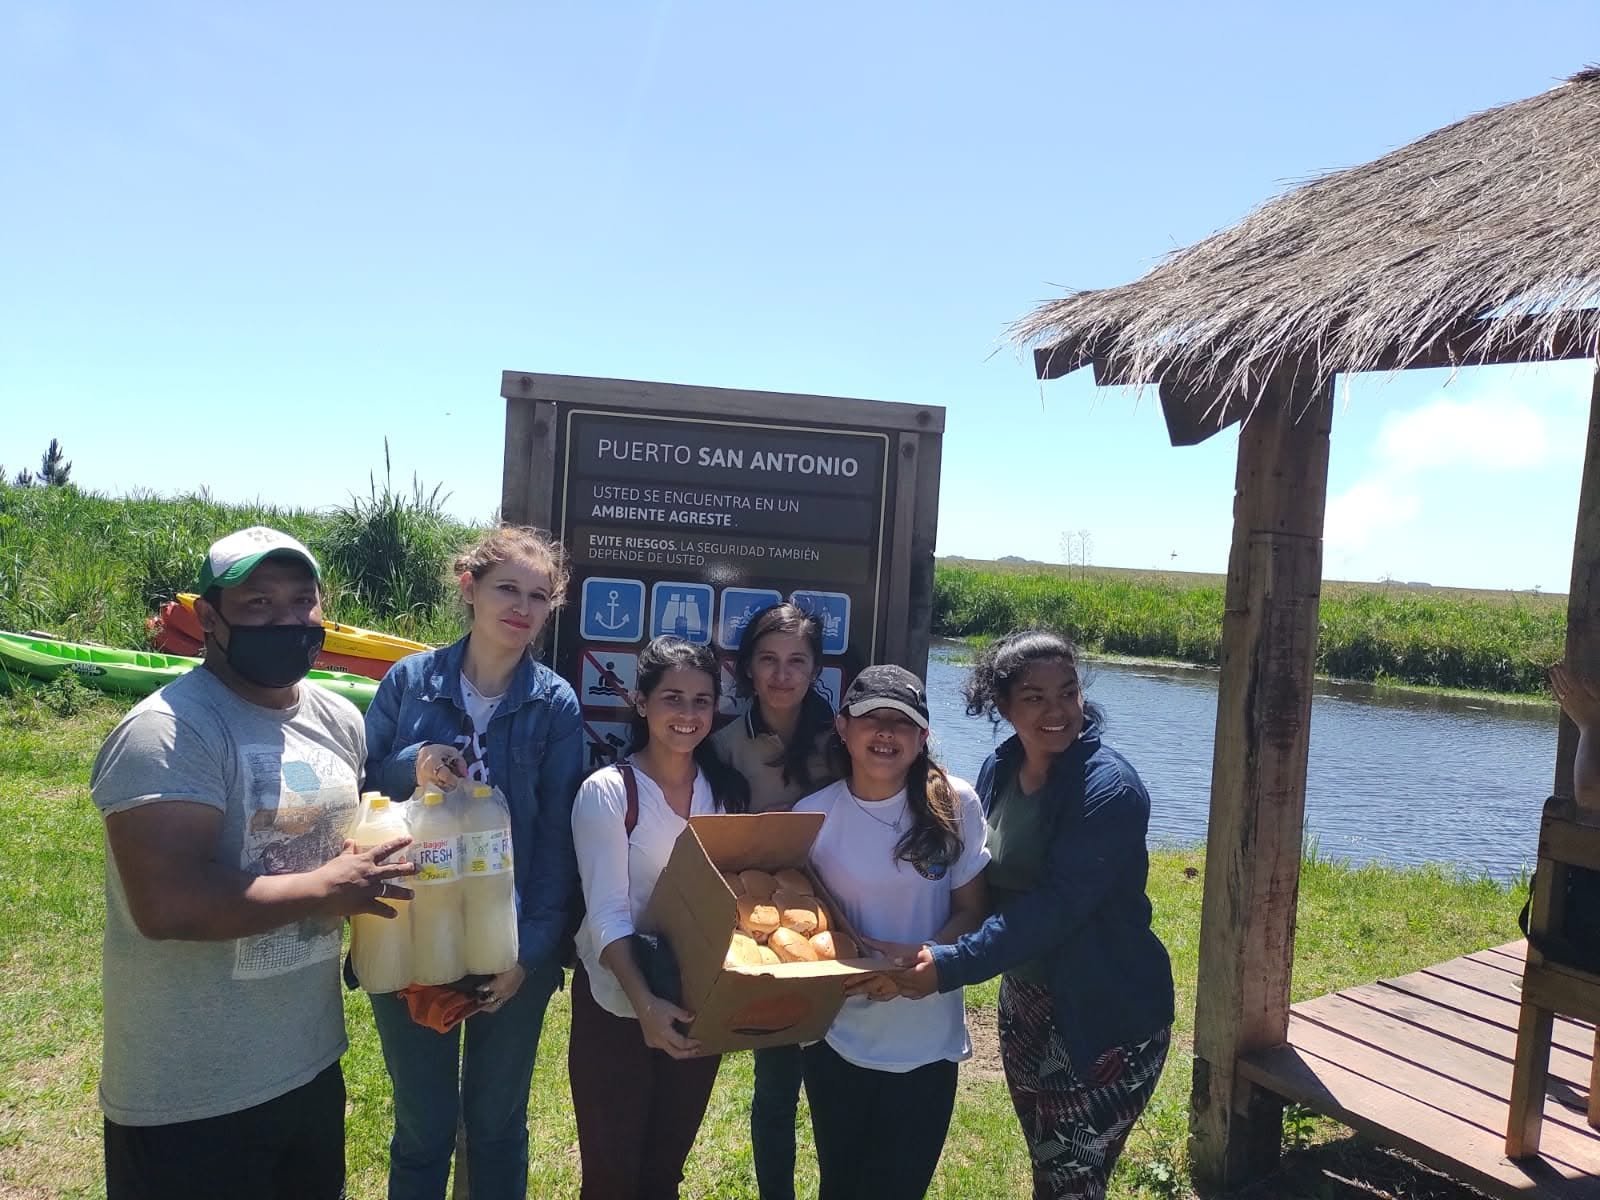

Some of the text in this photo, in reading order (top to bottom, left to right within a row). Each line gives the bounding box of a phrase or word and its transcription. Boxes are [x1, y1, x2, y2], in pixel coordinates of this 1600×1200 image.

[598, 439, 859, 477] PUERTO SAN ANTONIO
[593, 485, 800, 513] USTED SE ENCUENTRA EN UN
[591, 504, 666, 522] AMBIENTE
[588, 547, 645, 562] DEPENDE
[647, 551, 663, 563] DE
[589, 534, 820, 561] EVITE RIESGOS. LA SEGURIDAD TAMBIÉN
[420, 848, 453, 864] FRESH
